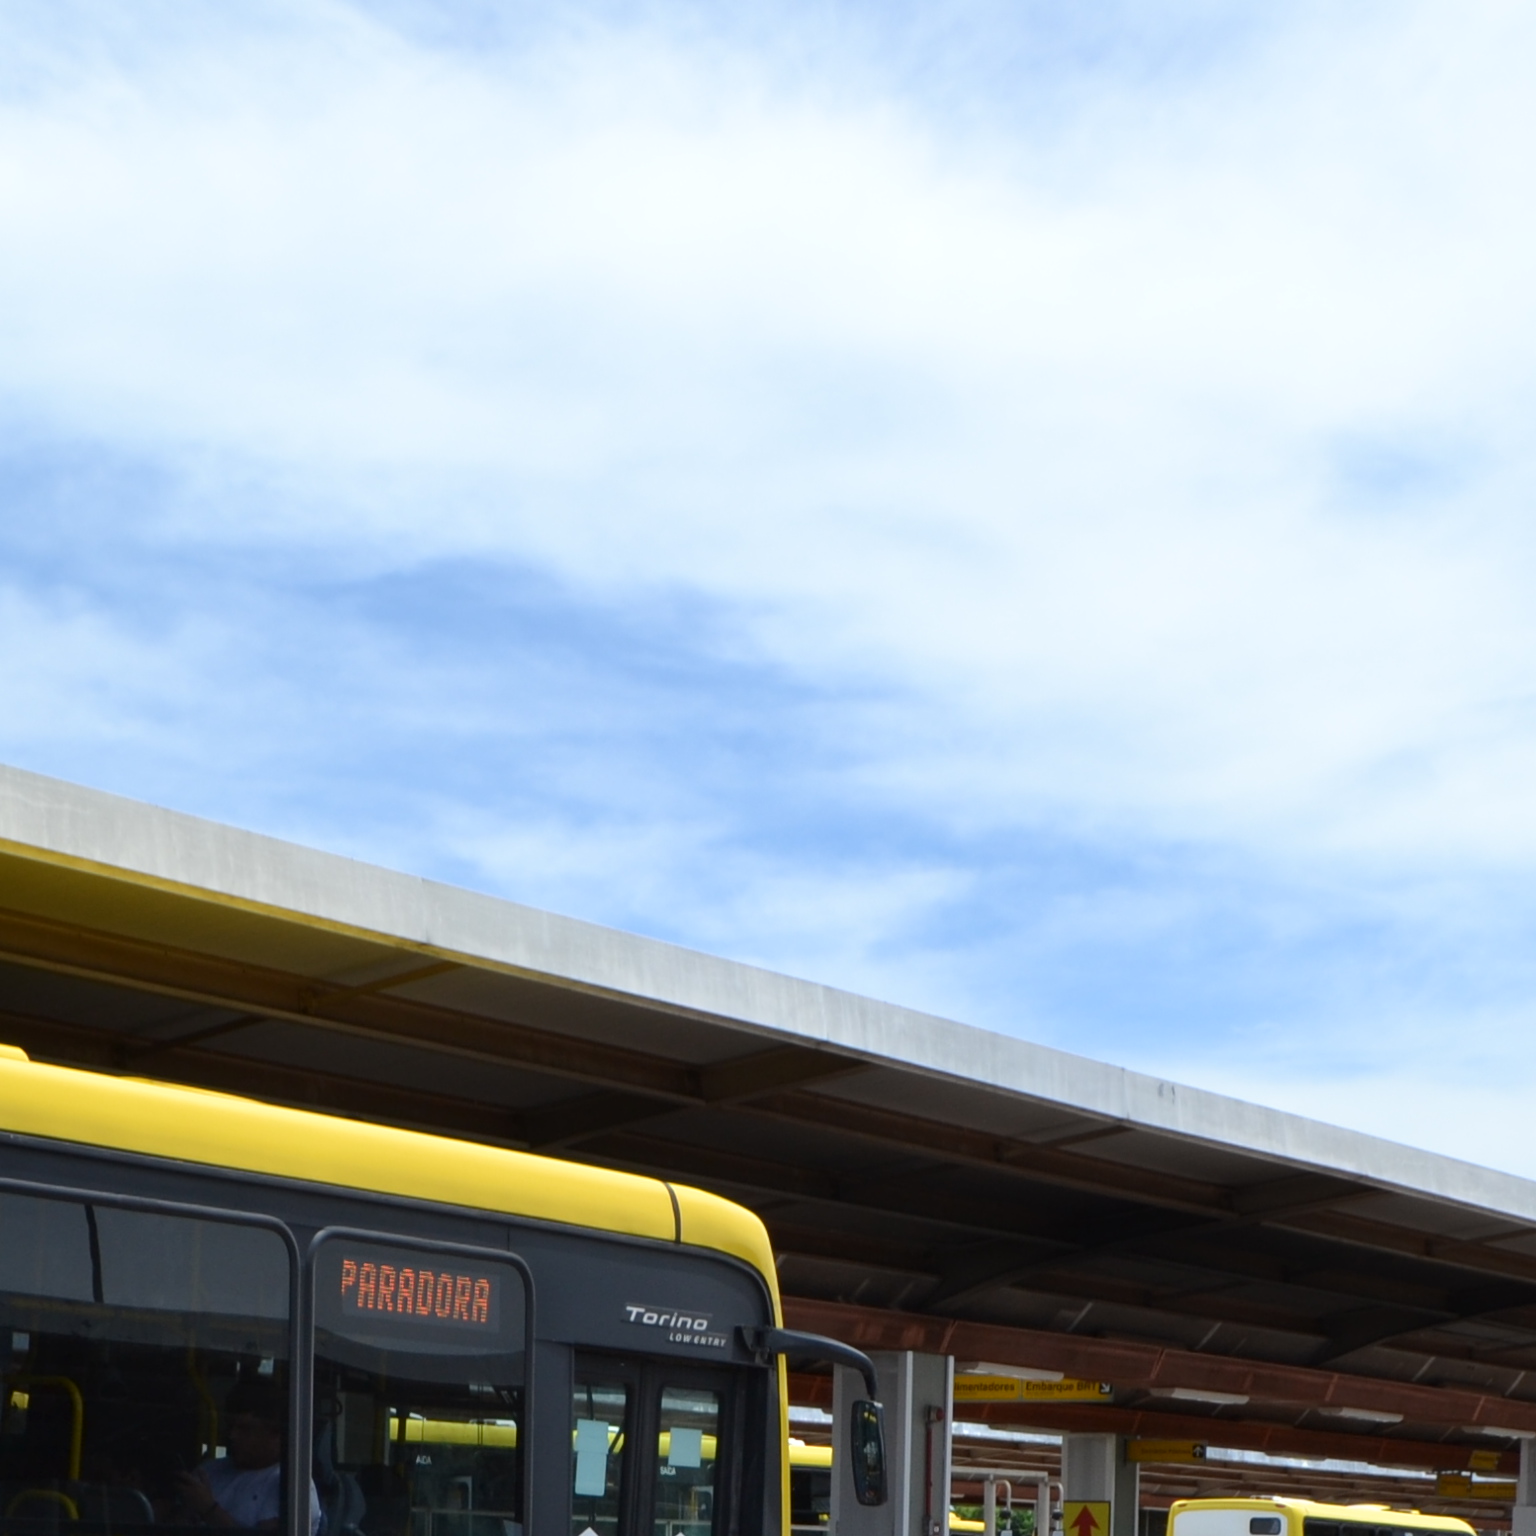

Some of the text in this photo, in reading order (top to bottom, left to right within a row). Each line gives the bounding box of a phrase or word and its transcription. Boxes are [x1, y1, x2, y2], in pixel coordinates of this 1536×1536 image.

[341, 1258, 490, 1323] PARADORA
[625, 1305, 708, 1331] Torino
[670, 1333, 692, 1344] LOW
[954, 1381, 1015, 1392] limentadores
[1025, 1381, 1097, 1393] Embarque BRT
